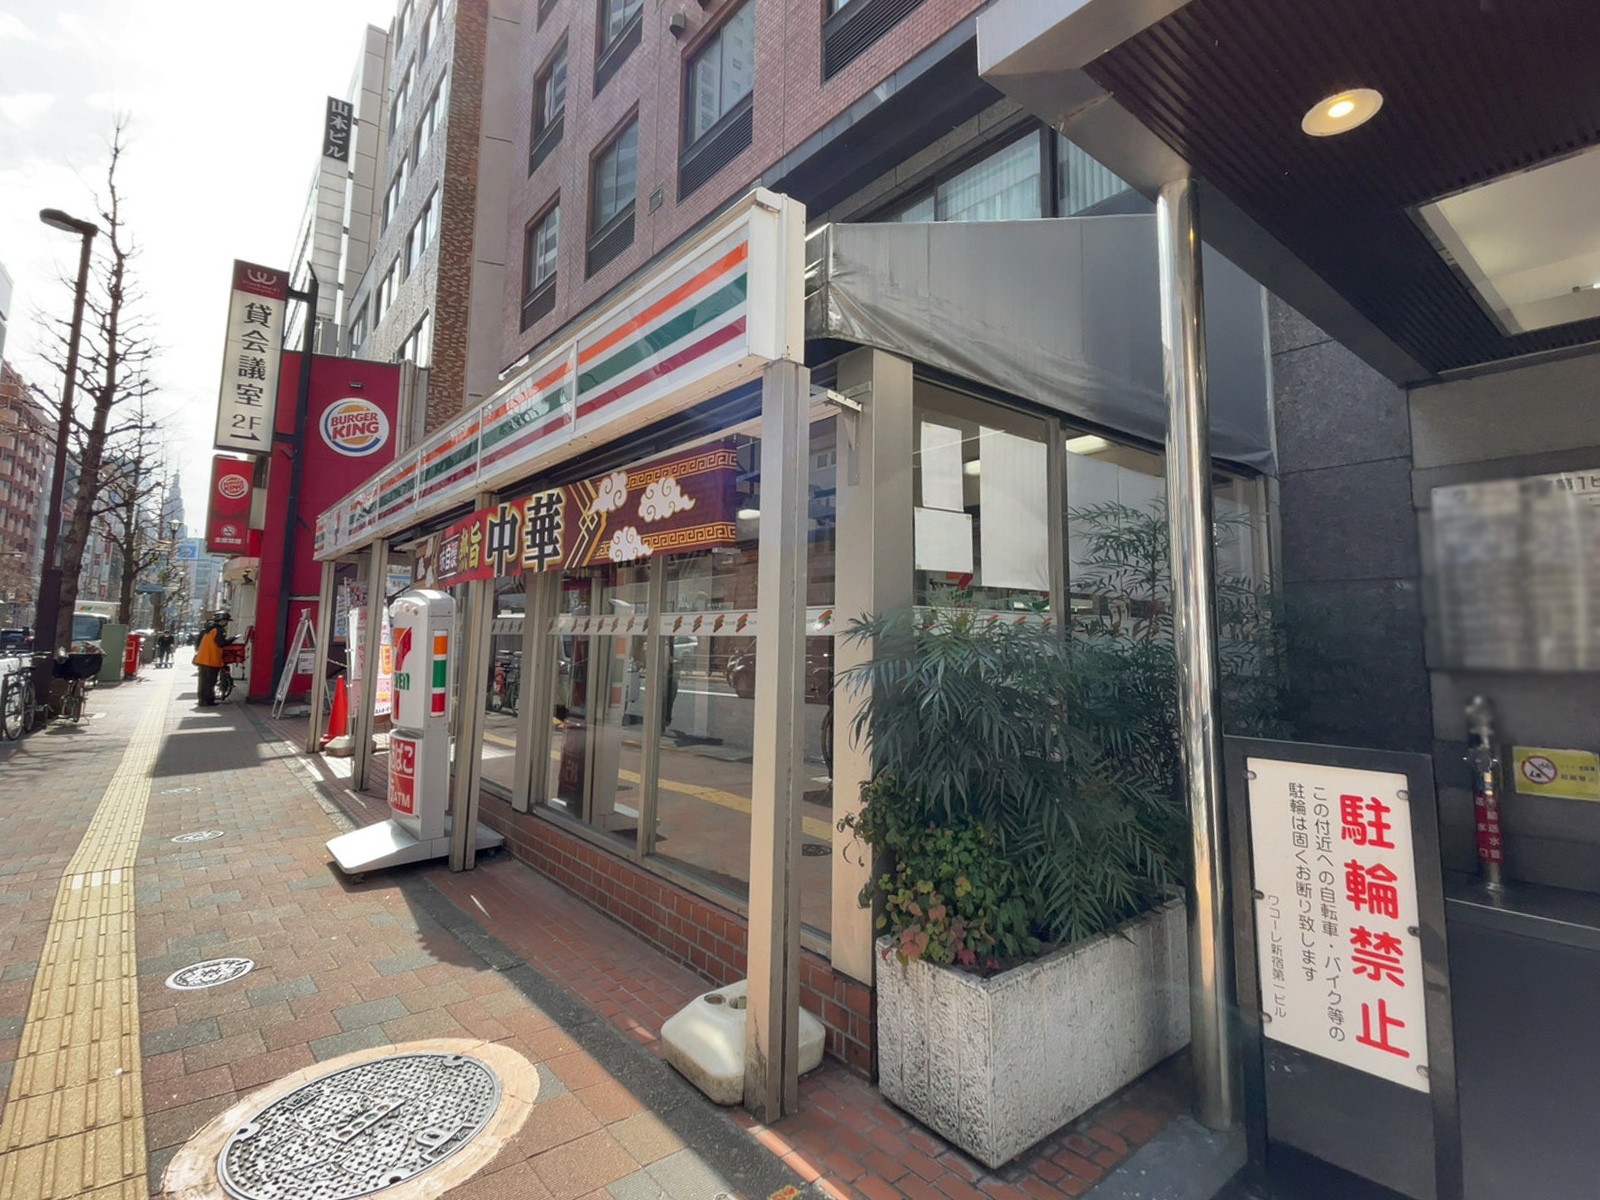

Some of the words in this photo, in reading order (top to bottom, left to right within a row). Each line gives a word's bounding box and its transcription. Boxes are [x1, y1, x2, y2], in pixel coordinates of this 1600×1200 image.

[234, 302, 273, 408] 貸会議室
[231, 413, 262, 430] 2F
[330, 412, 378, 427] BURGER
[331, 421, 379, 441] KING
[485, 491, 564, 578] 中華
[1288, 781, 1318, 982] 駐輪は固くお断り致します
[1312, 785, 1346, 1042] この付近への自転車・バイク等の
[1339, 793, 1410, 1058] 駐輪禁止
[1267, 894, 1287, 1018] ワコーレ新宿第一ビル
